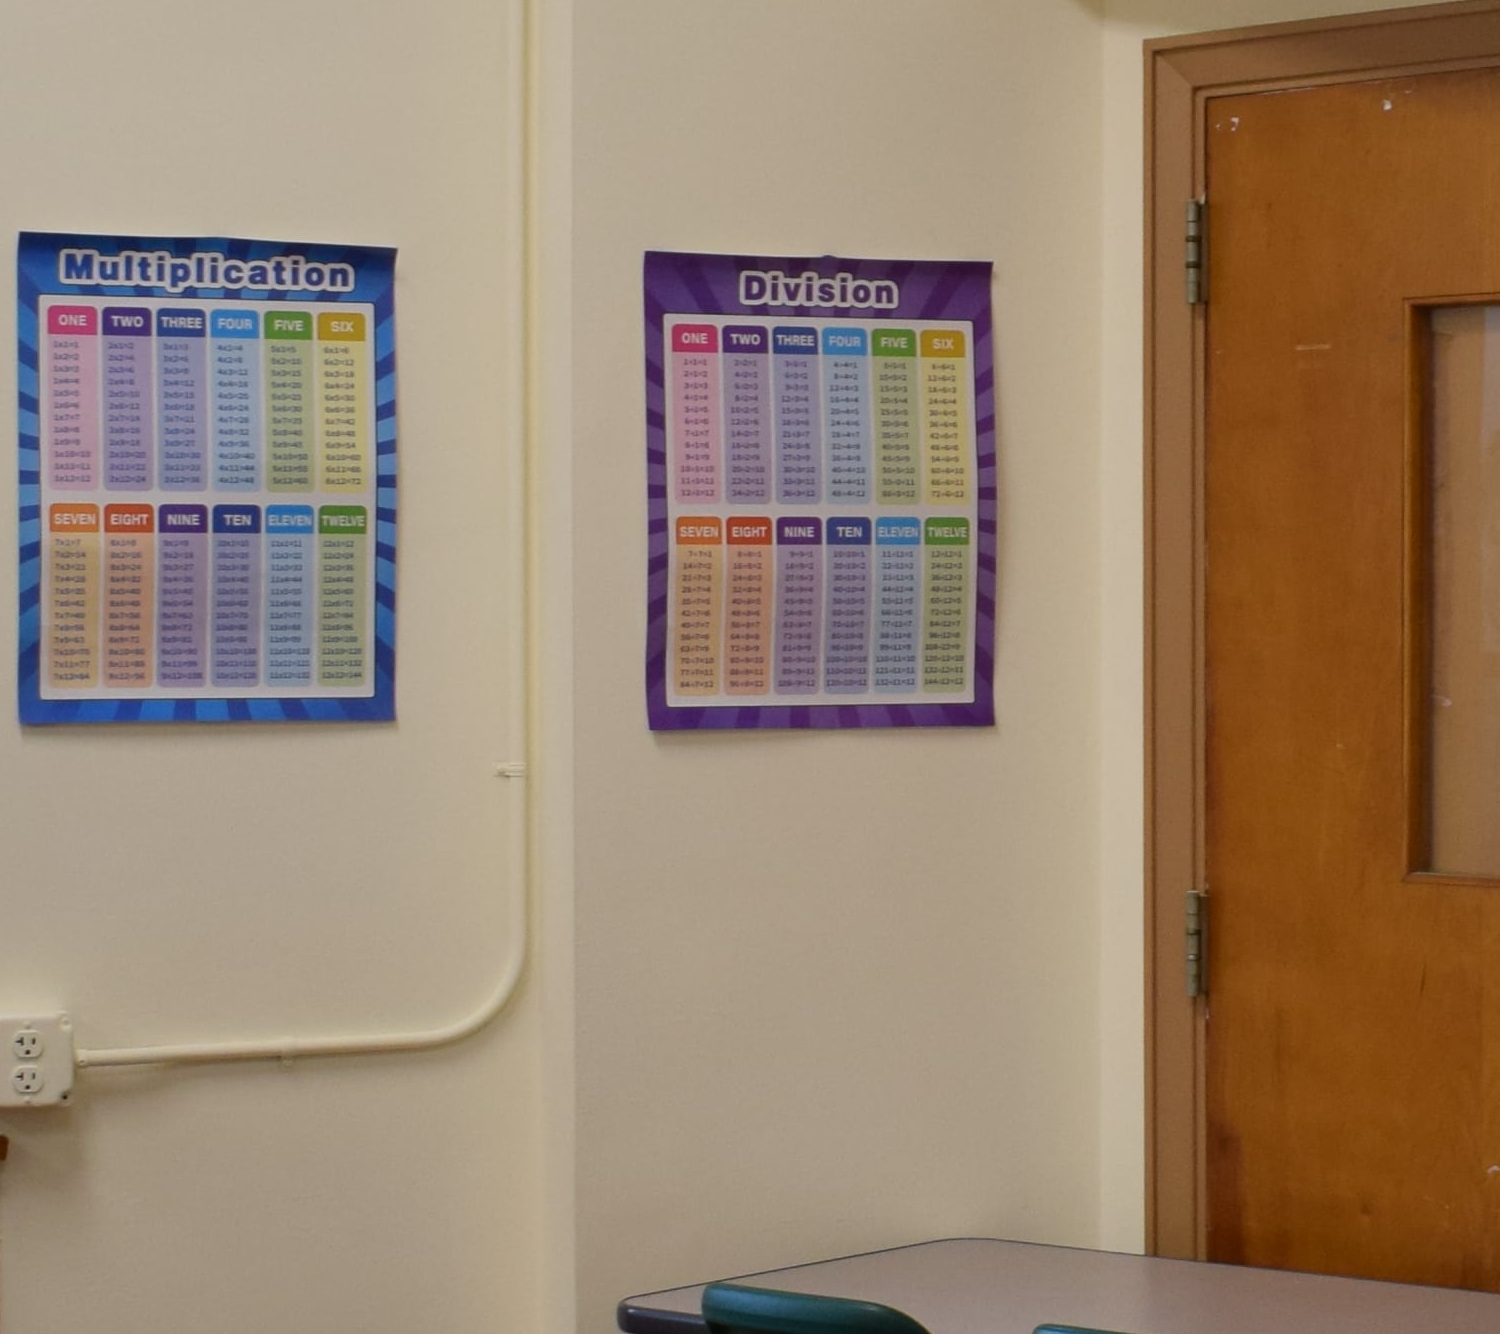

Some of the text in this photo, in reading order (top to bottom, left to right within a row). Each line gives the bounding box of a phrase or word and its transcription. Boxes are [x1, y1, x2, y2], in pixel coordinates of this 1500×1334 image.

[59, 249, 355, 293] Multiplication
[739, 271, 899, 308] Division
[58, 315, 353, 333] ONE TWO THREE FOUR FIVE SIX
[681, 333, 954, 350] ONE TWO THREE FOUR FIVE SIX
[54, 513, 364, 527] SEVEN EIGHT NINE TEN ELEVEN TWELVE
[680, 526, 968, 539] SEVEN EIGHT NINE TEN ELEVEN TWELVE
